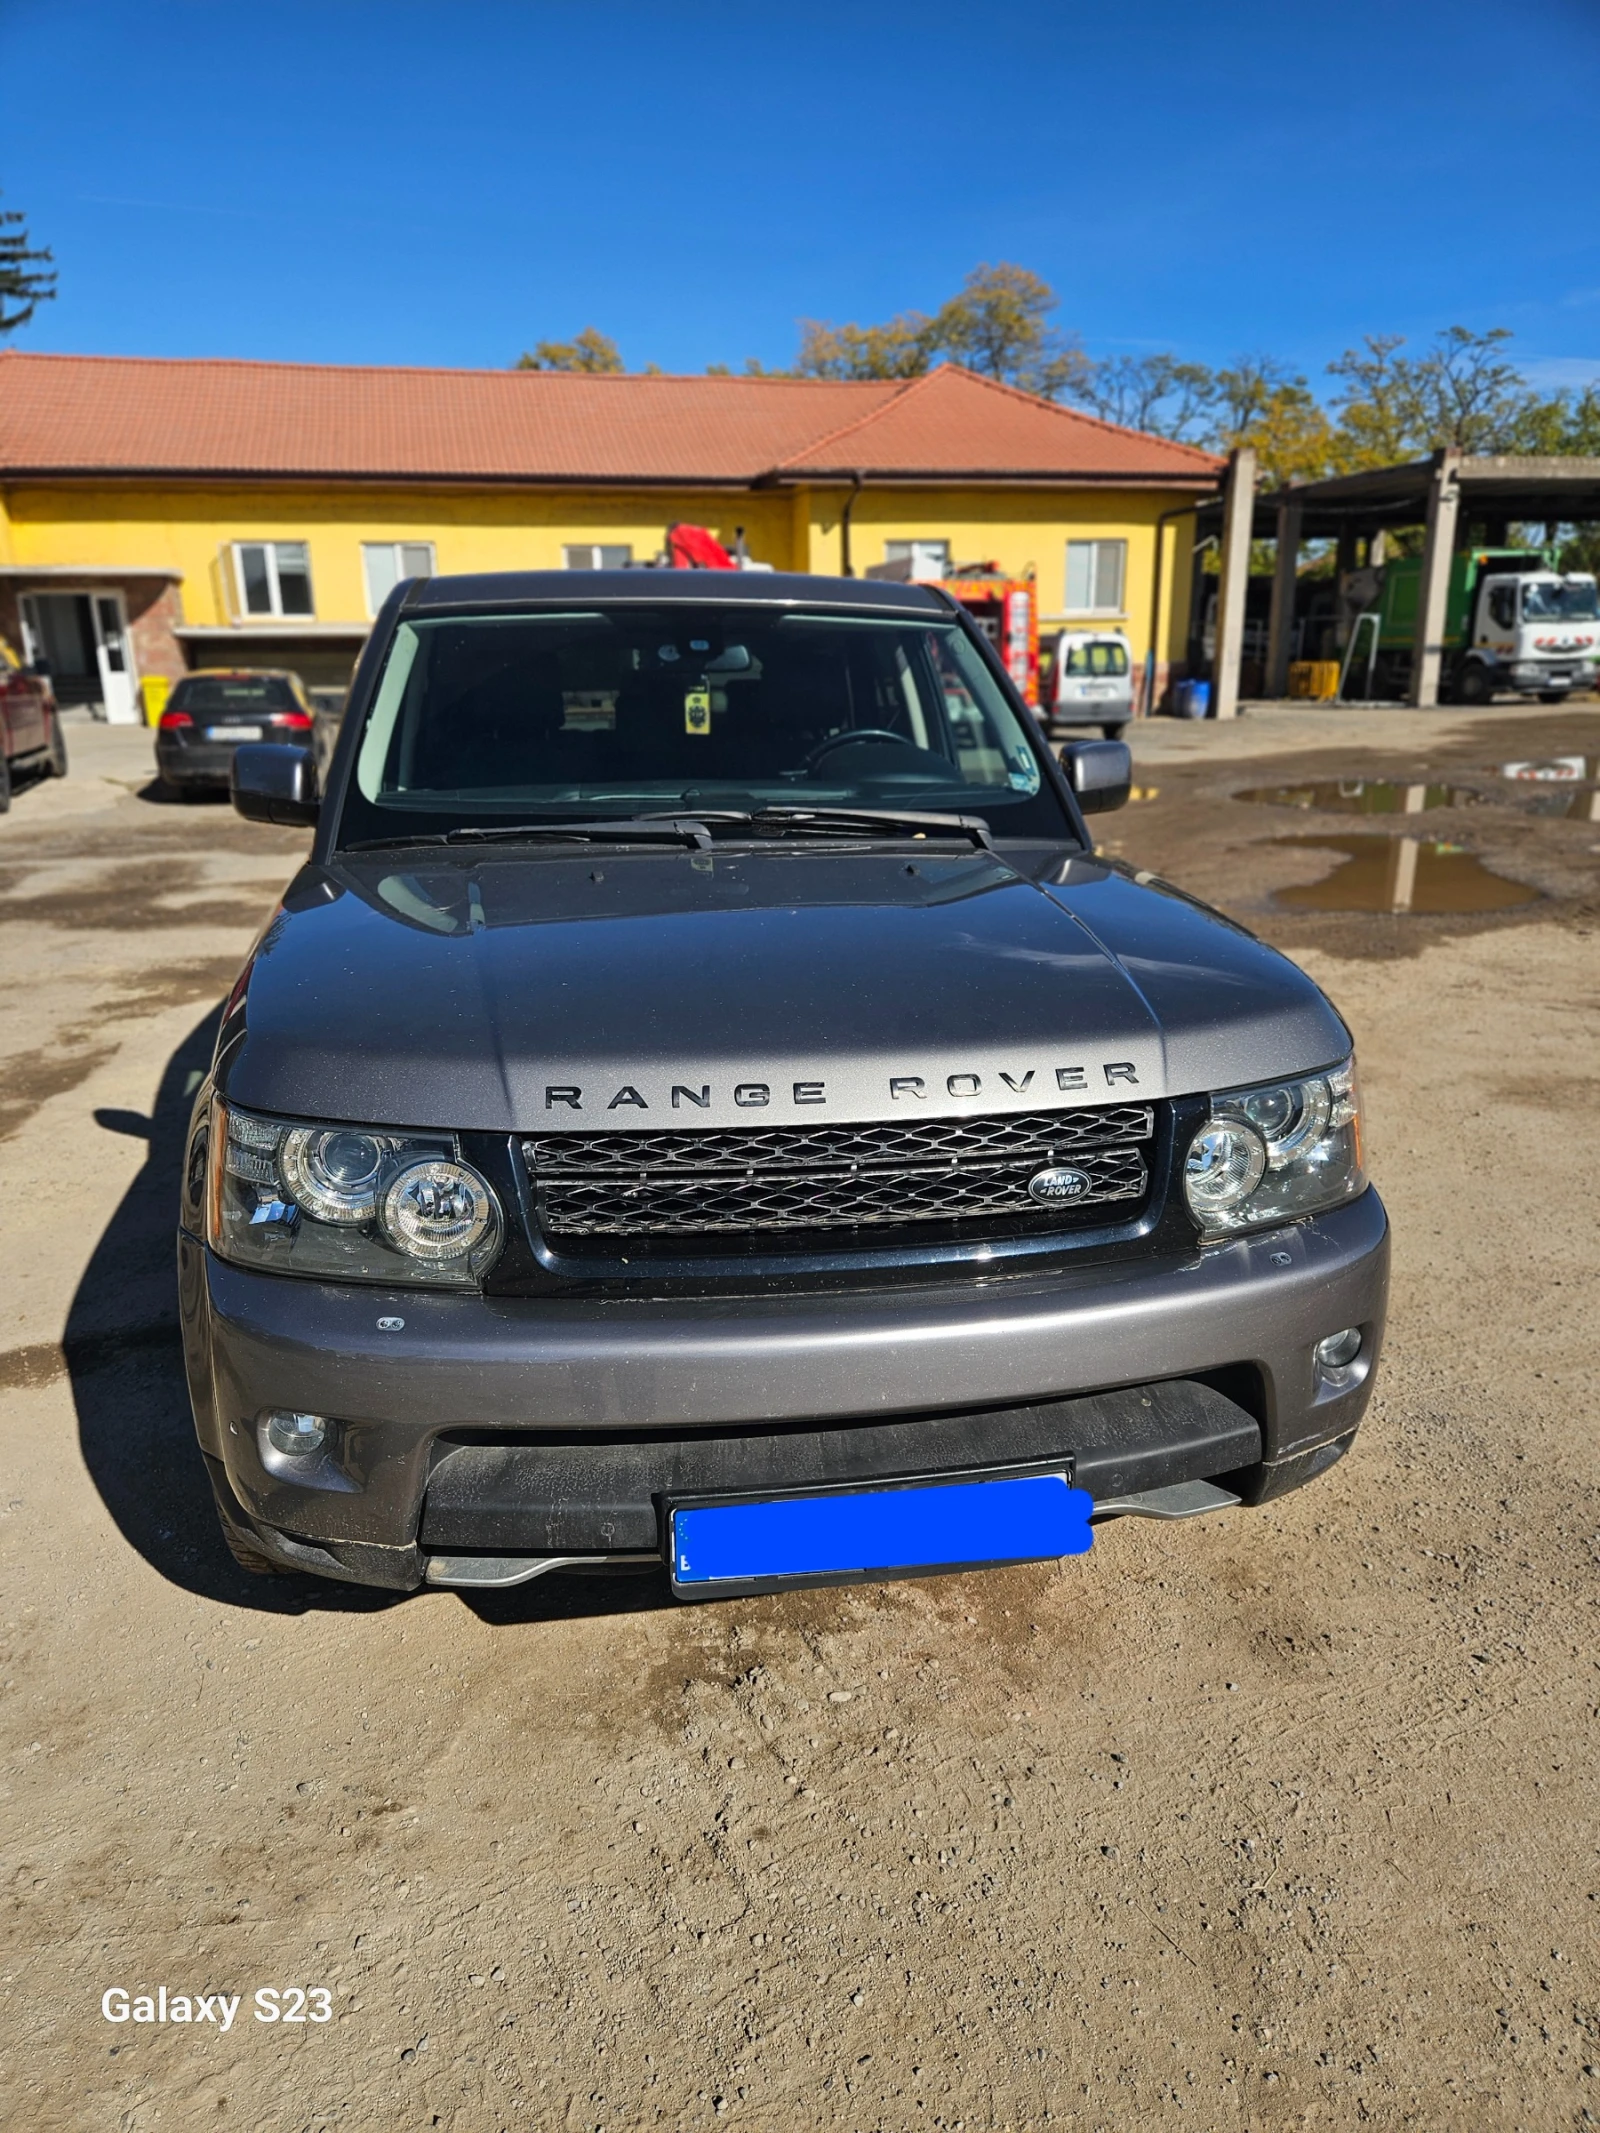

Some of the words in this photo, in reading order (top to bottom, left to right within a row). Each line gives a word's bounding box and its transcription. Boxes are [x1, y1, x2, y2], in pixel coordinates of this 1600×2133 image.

[545, 1081, 827, 1110] RANGE
[889, 1061, 1140, 1099] ROVER
[1043, 1174, 1073, 1187] LAND
[1046, 1184, 1082, 1196] ROVER
